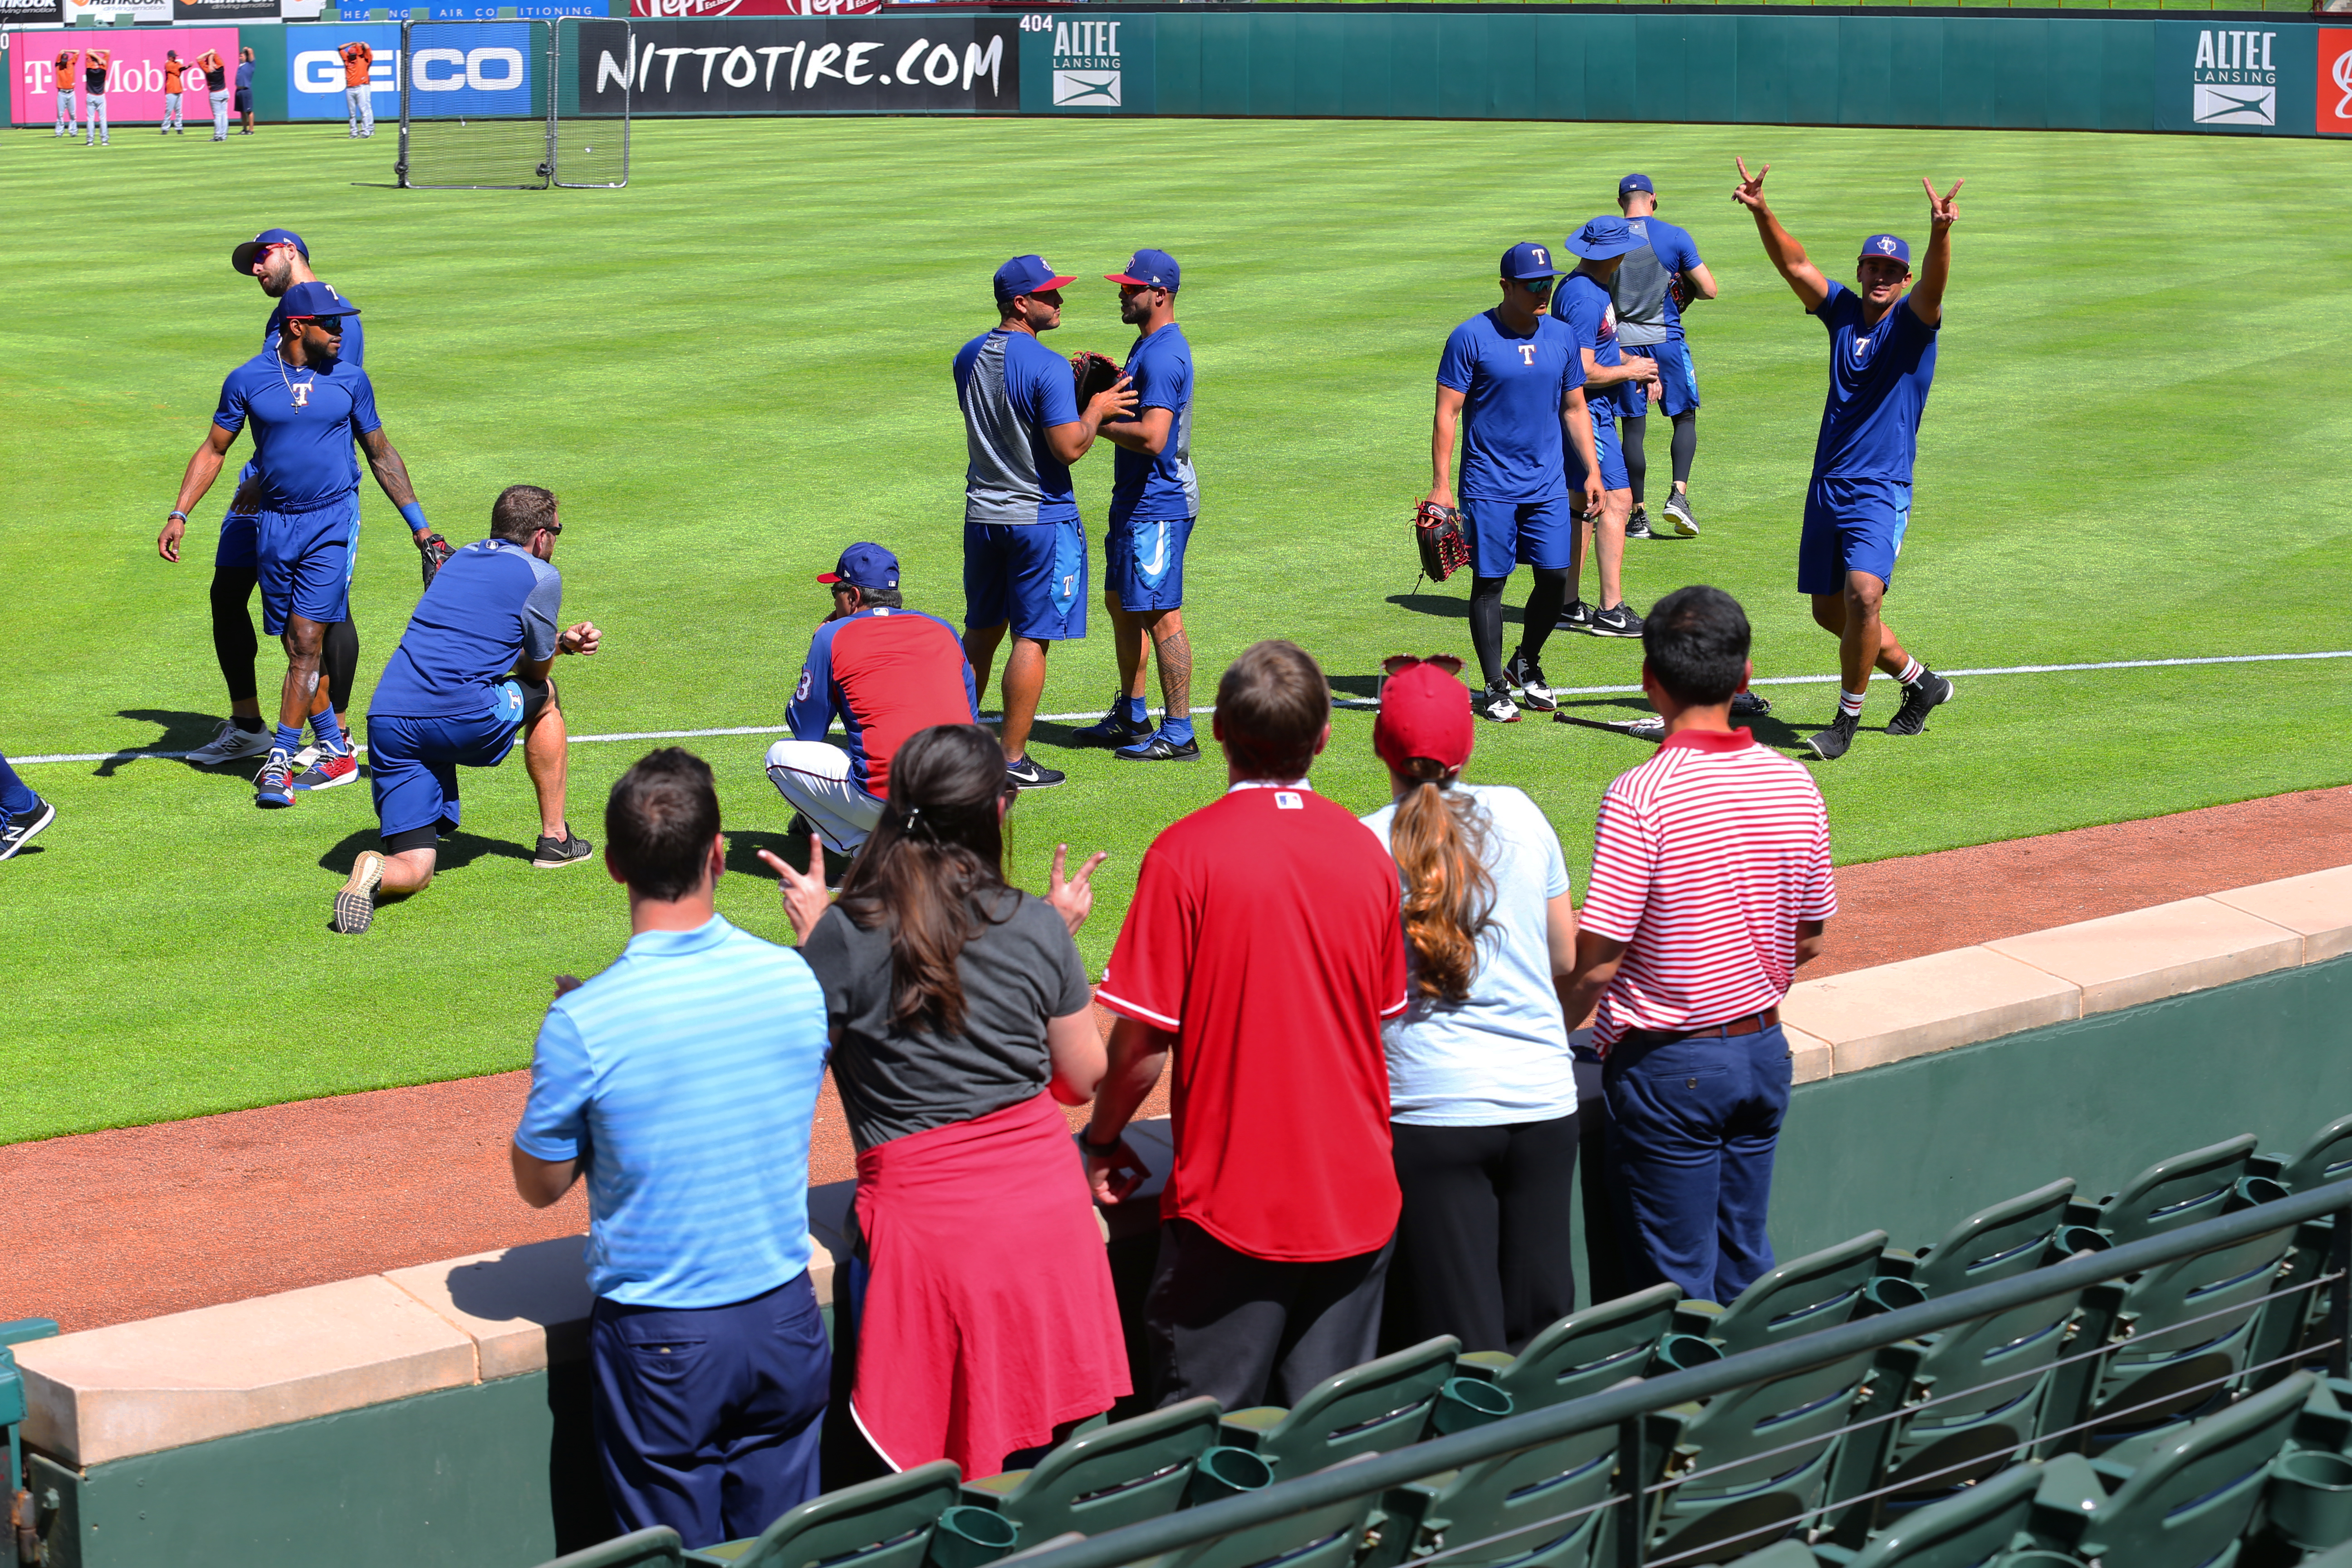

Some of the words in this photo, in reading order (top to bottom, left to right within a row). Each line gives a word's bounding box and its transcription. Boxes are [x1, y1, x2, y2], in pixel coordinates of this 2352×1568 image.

[344, 10, 408, 19] HEANG
[475, 7, 592, 16] COITIONING
[1019, 15, 1053, 32] 404
[1054, 22, 1121, 56] ALTEC
[2195, 30, 2276, 70] ALTEC
[596, 34, 1003, 97] NITTOTIRE.COM
[1053, 59, 1121, 68] LANSING
[2194, 71, 2276, 83] LANSING
[1532, 249, 1545, 265] T
[1518, 345, 1536, 366] T
[293, 383, 313, 405] T
[1063, 574, 1074, 597] T
